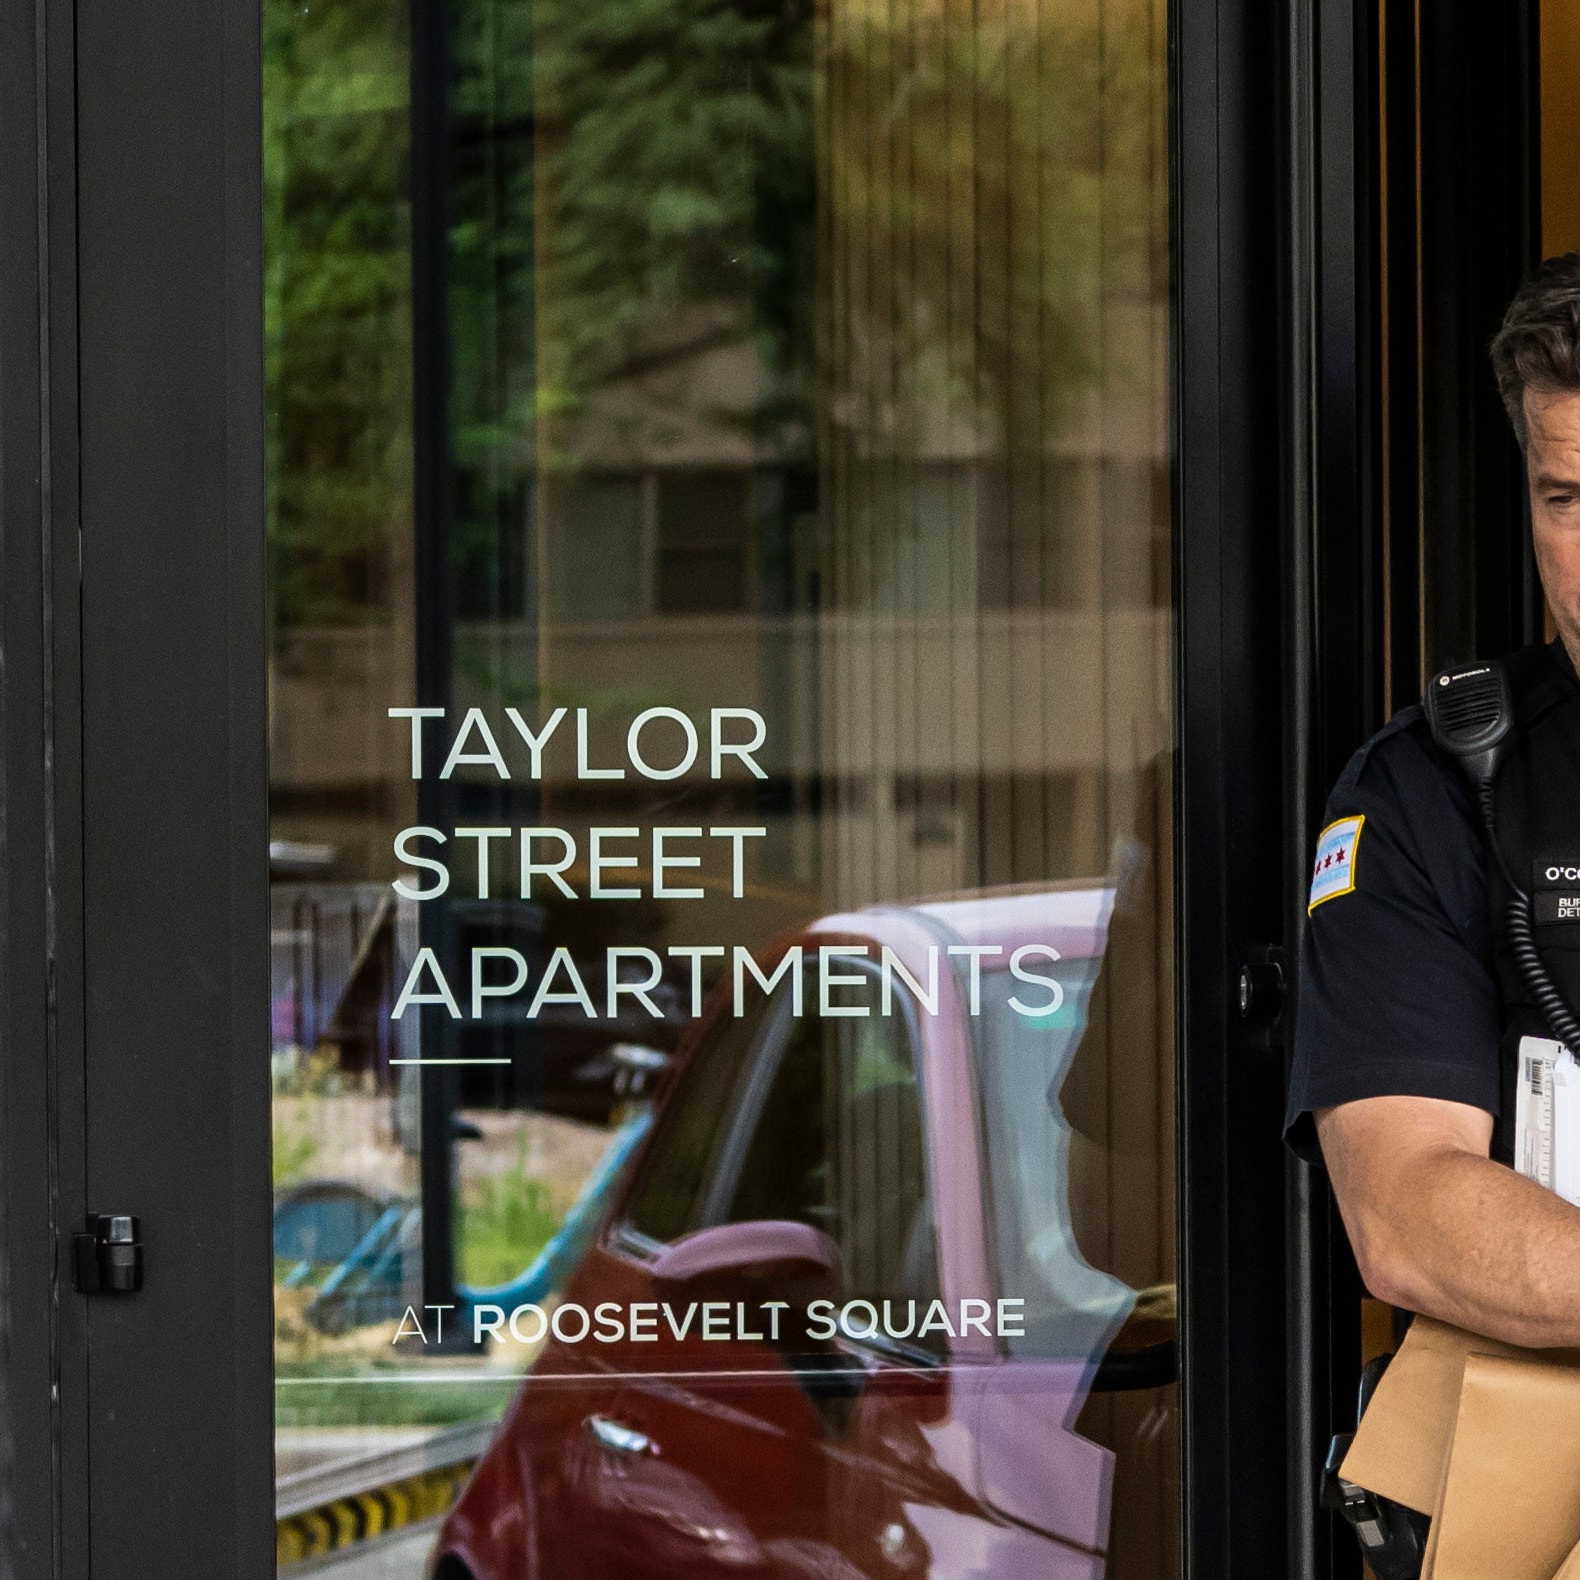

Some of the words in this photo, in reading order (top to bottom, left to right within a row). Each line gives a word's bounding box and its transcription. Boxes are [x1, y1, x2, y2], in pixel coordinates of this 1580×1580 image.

[388, 707, 769, 780] TAYLOR
[391, 826, 767, 901] STREET
[390, 944, 1064, 1021] APARTMENTS
[392, 1304, 454, 1345] AT
[473, 1302, 790, 1345] ROOSEVELT
[806, 1298, 1025, 1341] SQUARE
